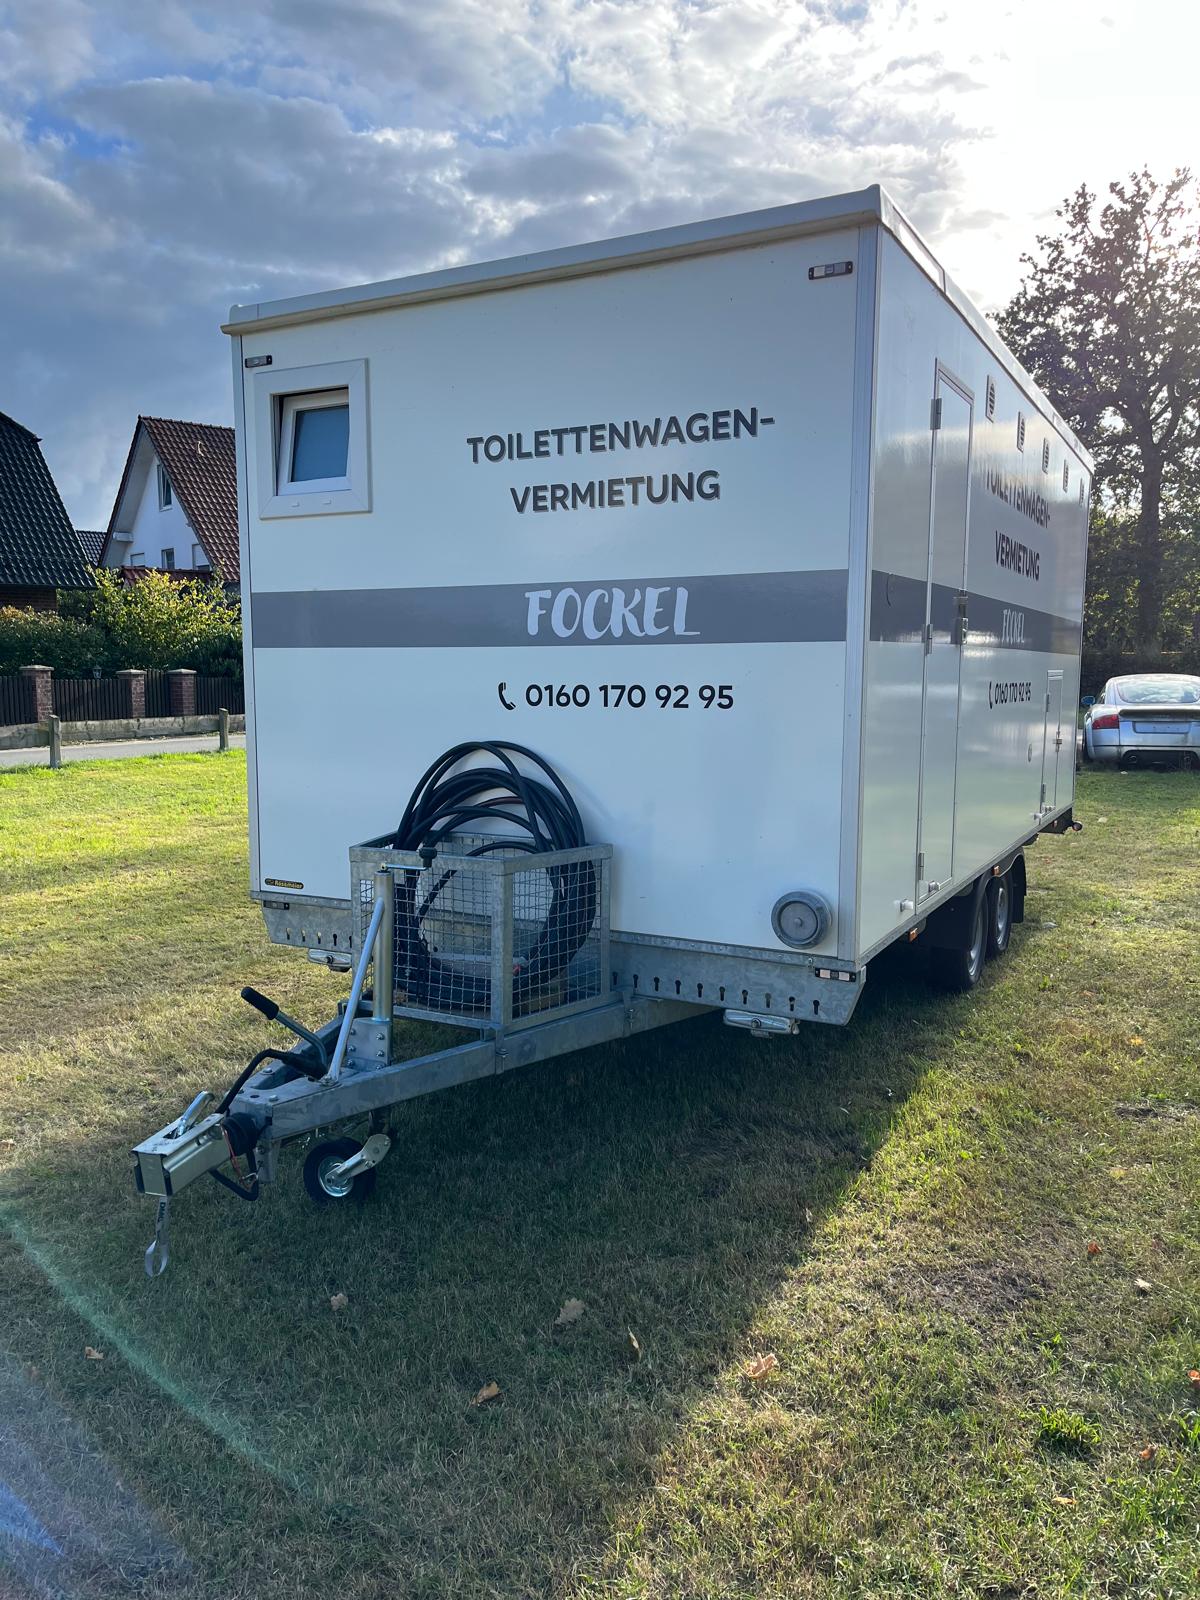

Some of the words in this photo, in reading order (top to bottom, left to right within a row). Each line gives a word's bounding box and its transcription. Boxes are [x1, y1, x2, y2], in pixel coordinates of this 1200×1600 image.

[466, 407, 775, 464] TOILETTENWAGEN-
[509, 470, 721, 514] VERMIETUNG
[994, 529, 1040, 581] VERMIETUNG
[524, 586, 701, 640] FOCKEL
[525, 684, 590, 708] 0160
[599, 684, 646, 708] 170
[655, 684, 689, 709] 92
[698, 685, 734, 709] 95
